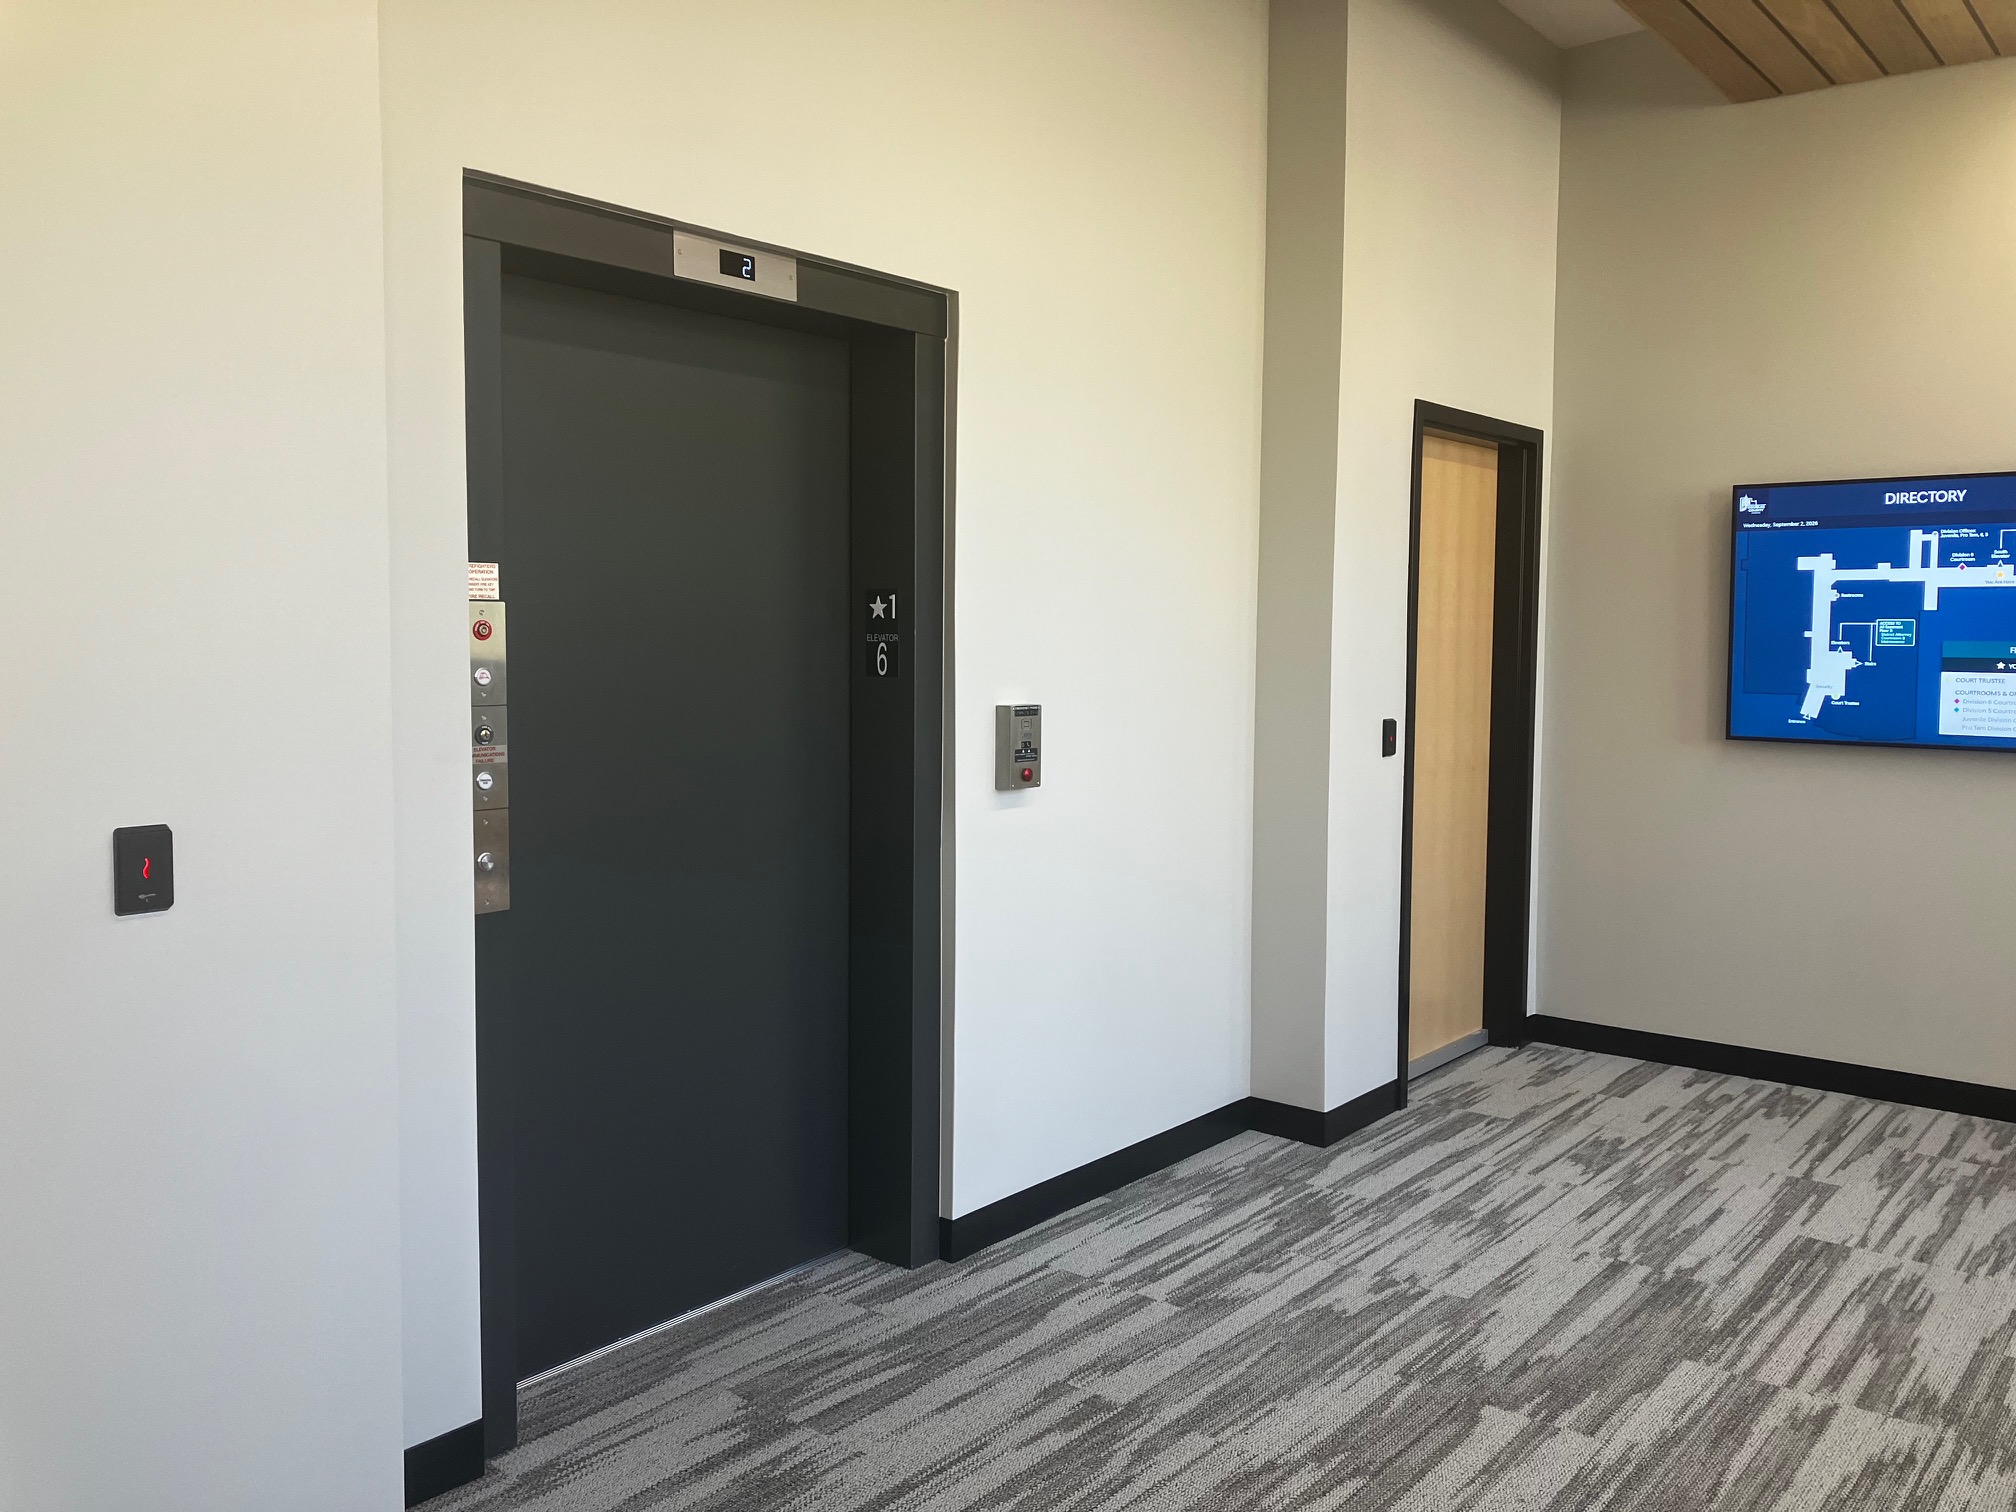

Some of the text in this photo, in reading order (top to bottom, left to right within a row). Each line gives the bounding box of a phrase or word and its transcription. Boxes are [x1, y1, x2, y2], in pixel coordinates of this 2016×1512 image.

[742, 257, 752, 278] 2
[1885, 489, 1968, 505] DIRECTORY
[866, 633, 899, 642] ELEVATOR
[877, 642, 888, 676] 6
